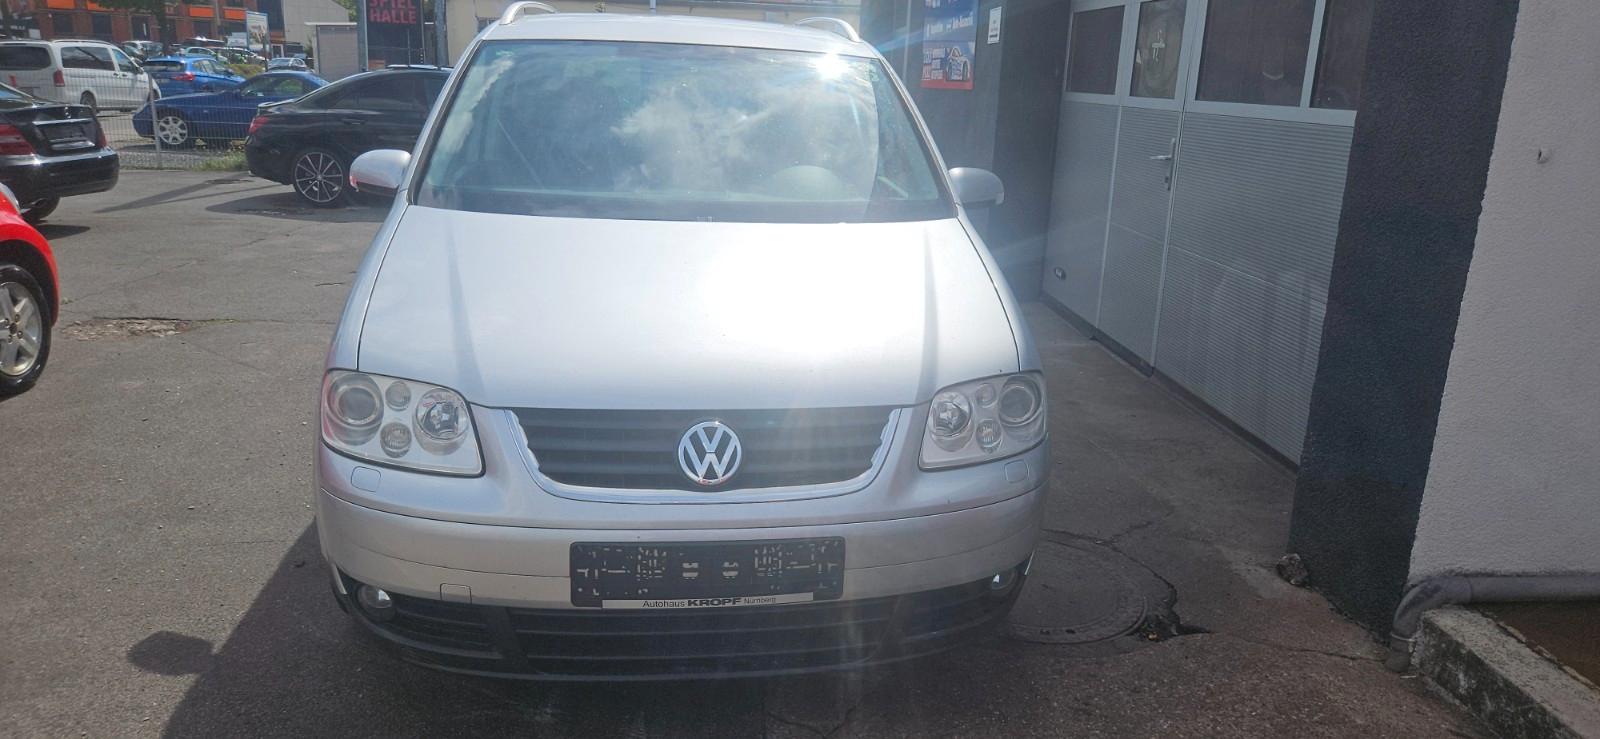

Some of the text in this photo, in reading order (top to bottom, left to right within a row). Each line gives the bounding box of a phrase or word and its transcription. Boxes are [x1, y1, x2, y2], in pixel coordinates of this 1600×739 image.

[369, 8, 416, 24] HALLE
[679, 421, 741, 485] VW
[642, 600, 685, 608] Autohaus
[687, 597, 741, 607] KROPF
